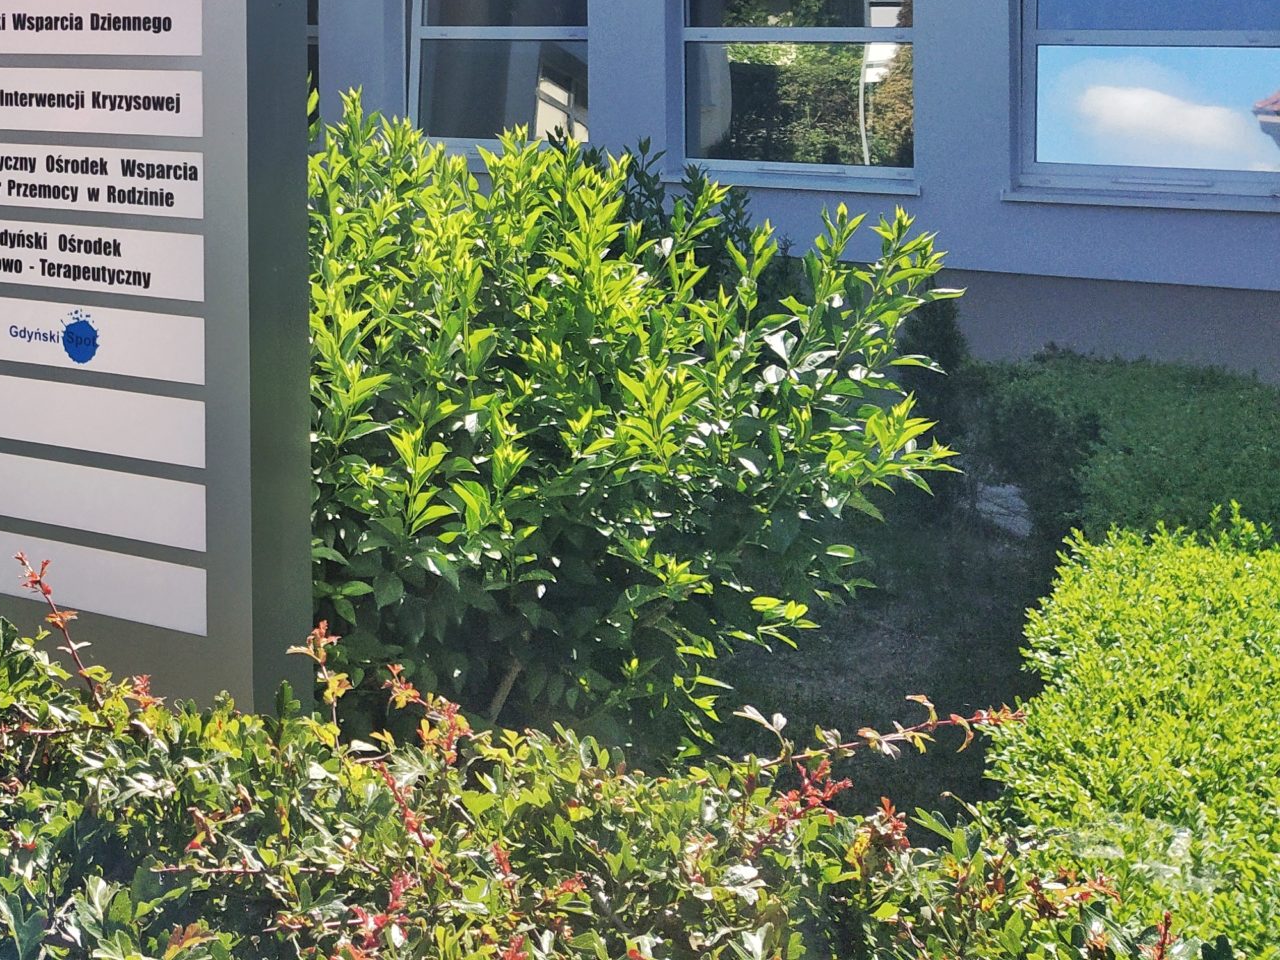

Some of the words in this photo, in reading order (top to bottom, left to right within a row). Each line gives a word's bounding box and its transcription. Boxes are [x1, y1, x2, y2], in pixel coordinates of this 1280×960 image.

[12, 13, 83, 32] Wsparcia
[90, 13, 173, 34] Dziennego
[0, 89, 85, 110] Interwencji
[92, 91, 181, 114] Kryzysowej
[45, 155, 108, 176] Ośrodek
[121, 159, 199, 181] Wsparcia
[7, 179, 79, 203] Przemocy
[87, 187, 100, 202] w
[107, 185, 175, 207] Rodzinie
[58, 233, 122, 257] Ośrodek
[39, 258, 151, 289] Terapeutyczny
[9, 325, 60, 343] Gdyński
